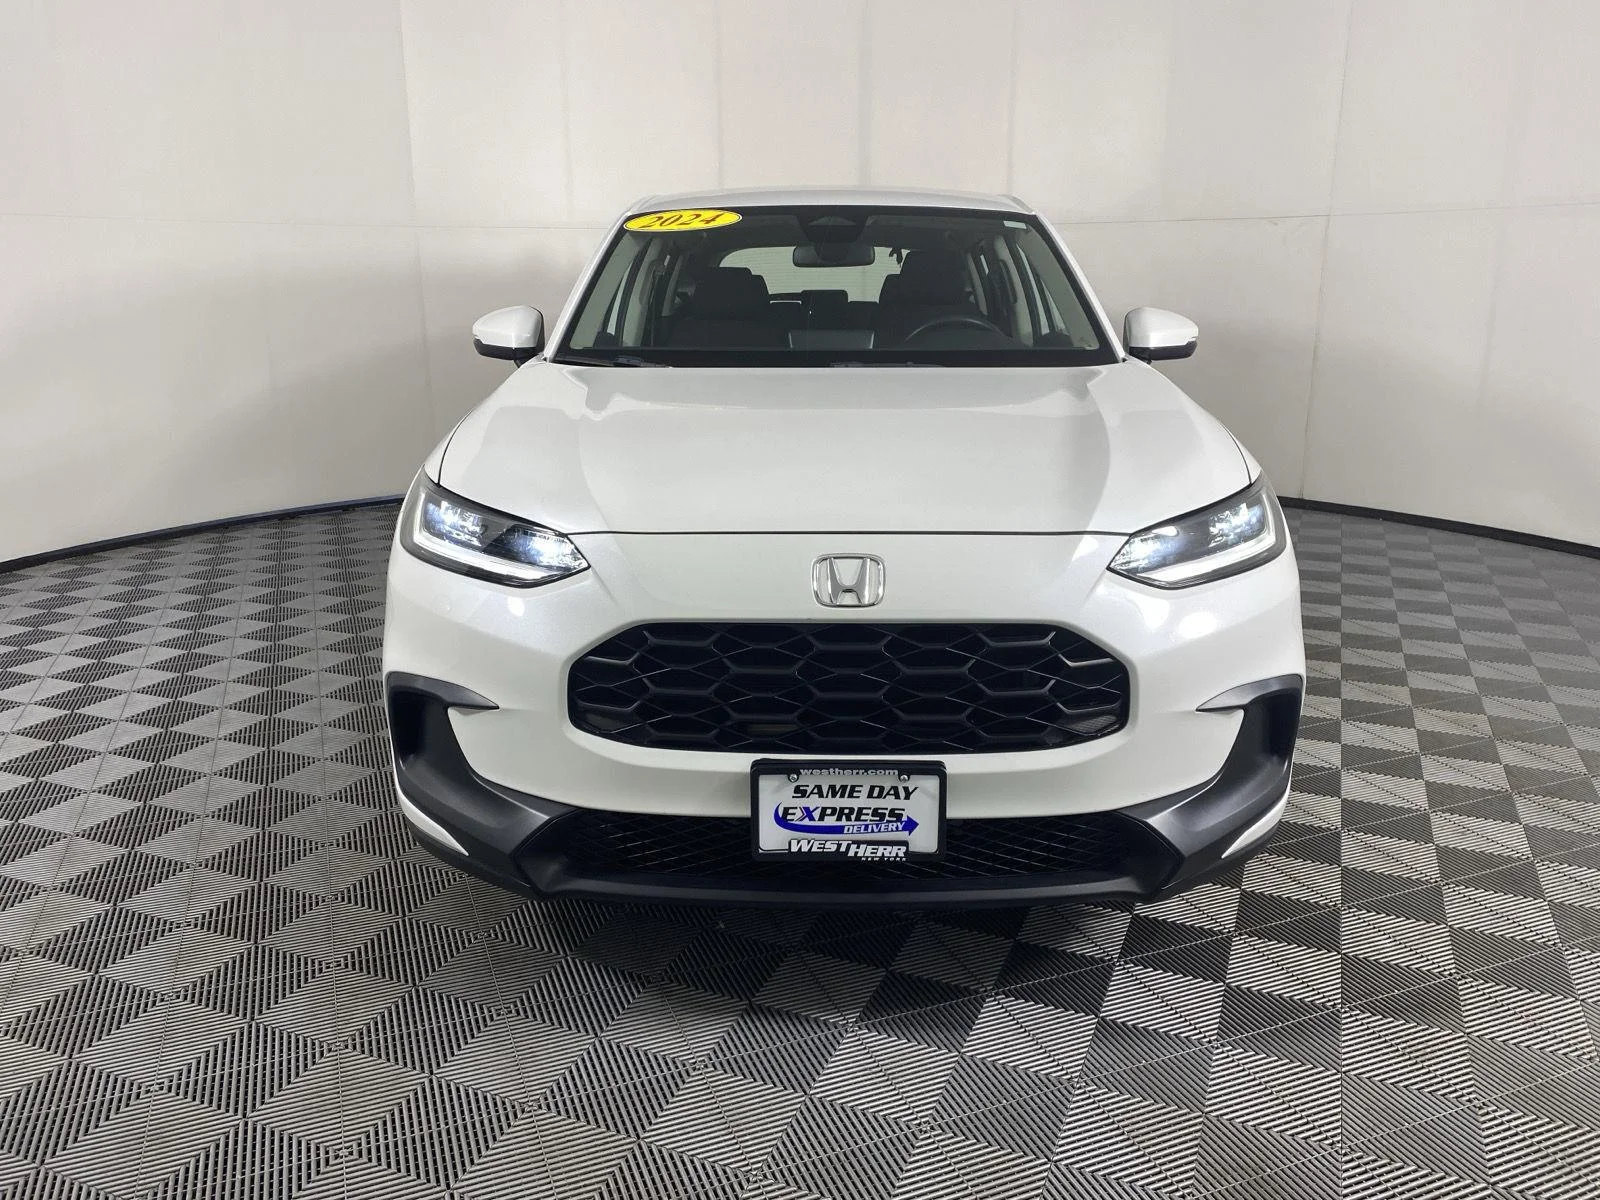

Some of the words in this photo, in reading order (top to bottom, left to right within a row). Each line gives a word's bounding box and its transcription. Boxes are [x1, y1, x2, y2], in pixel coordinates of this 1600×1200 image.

[638, 213, 725, 228] 2024
[800, 768, 898, 776] westherr.com
[792, 785, 863, 799] SAME
[867, 785, 918, 800] DAY
[781, 806, 905, 822] EXPRESS
[844, 821, 905, 834] DELIVERY
